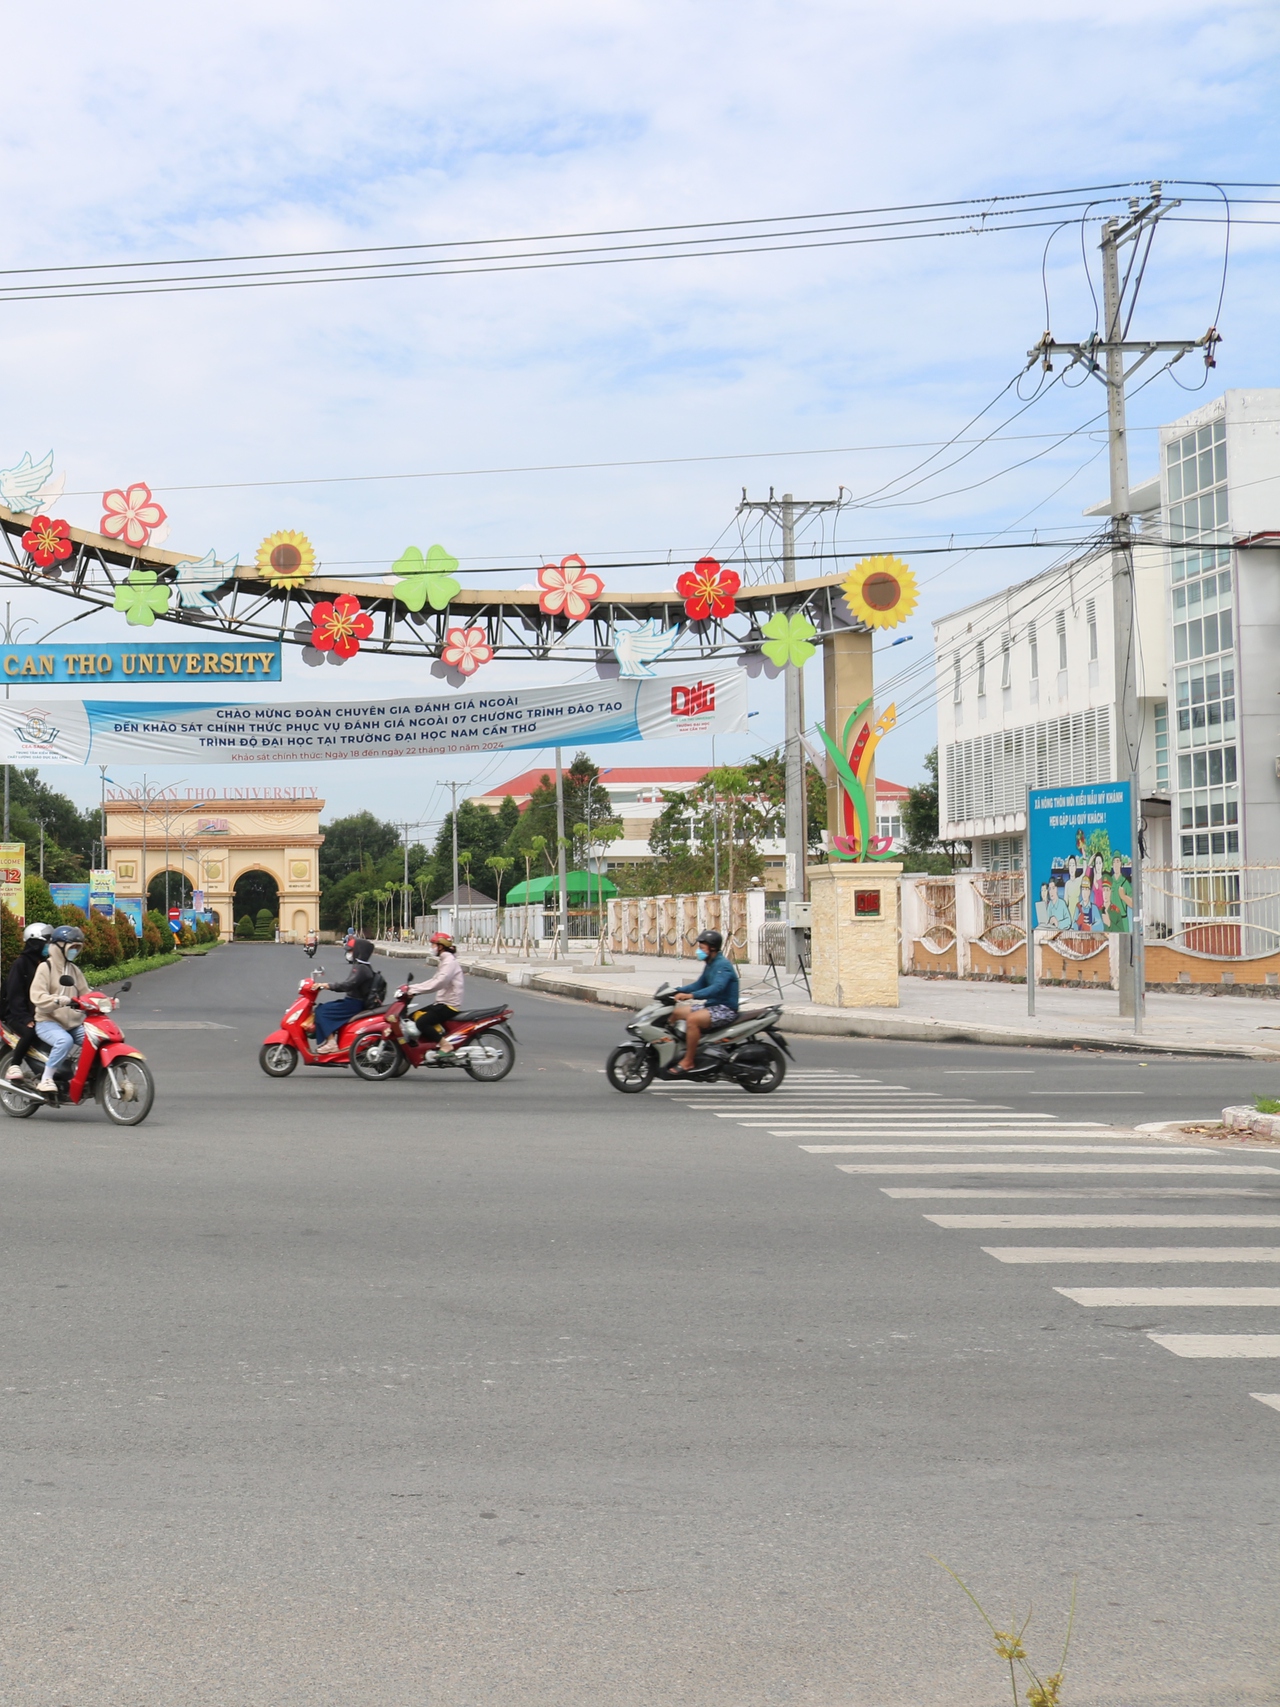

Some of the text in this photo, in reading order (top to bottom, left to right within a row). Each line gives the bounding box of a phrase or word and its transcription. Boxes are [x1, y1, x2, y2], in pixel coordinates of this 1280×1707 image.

[3, 655, 55, 676] CAN
[64, 653, 113, 675] THO
[121, 652, 275, 675] UNIVERSITY
[216, 697, 519, 719] CHÀO MỪNG ĐOÀN CHUYÊN GIA ĐÁNH GIÁ NGOÀI
[671, 680, 715, 717] DNC
[114, 721, 139, 733] ĐẾN
[181, 721, 203, 732] SÁT
[207, 721, 245, 732] CHÍNH
[249, 721, 282, 733] THỨC
[286, 723, 320, 734] PHỤC
[323, 722, 341, 733] VỤ
[344, 719, 380, 731] ĐÁNH
[384, 718, 405, 729] GIÁ
[409, 714, 448, 727] NGOÀI
[452, 715, 466, 725] 07
[470, 709, 523, 723] CHƯƠNG
[527, 705, 564, 719] TRÌNH
[567, 702, 594, 715] ĐÀO
[598, 701, 623, 715] TẠO
[199, 721, 537, 748] TRÌNH ĐỘ ĐẠI HỌC TẠI TRƯỜNG ĐẠI HỌC NAM CẦN THƠ
[256, 751, 271, 761] sát
[272, 751, 298, 761] chính
[325, 750, 349, 761] Ngày
[350, 750, 360, 758] 18
[361, 747, 379, 757] đến
[380, 748, 402, 758] ngày
[406, 747, 417, 755] 22
[418, 745, 446, 755] tháng
[447, 744, 457, 752] 10
[459, 742, 480, 751] năm
[482, 741, 504, 750] 2024
[106, 786, 319, 800] NAM CAN THO UNIVERSITY
[1106, 789, 1124, 804] KHÁNH
[1087, 810, 1104, 824] KHÁCH
